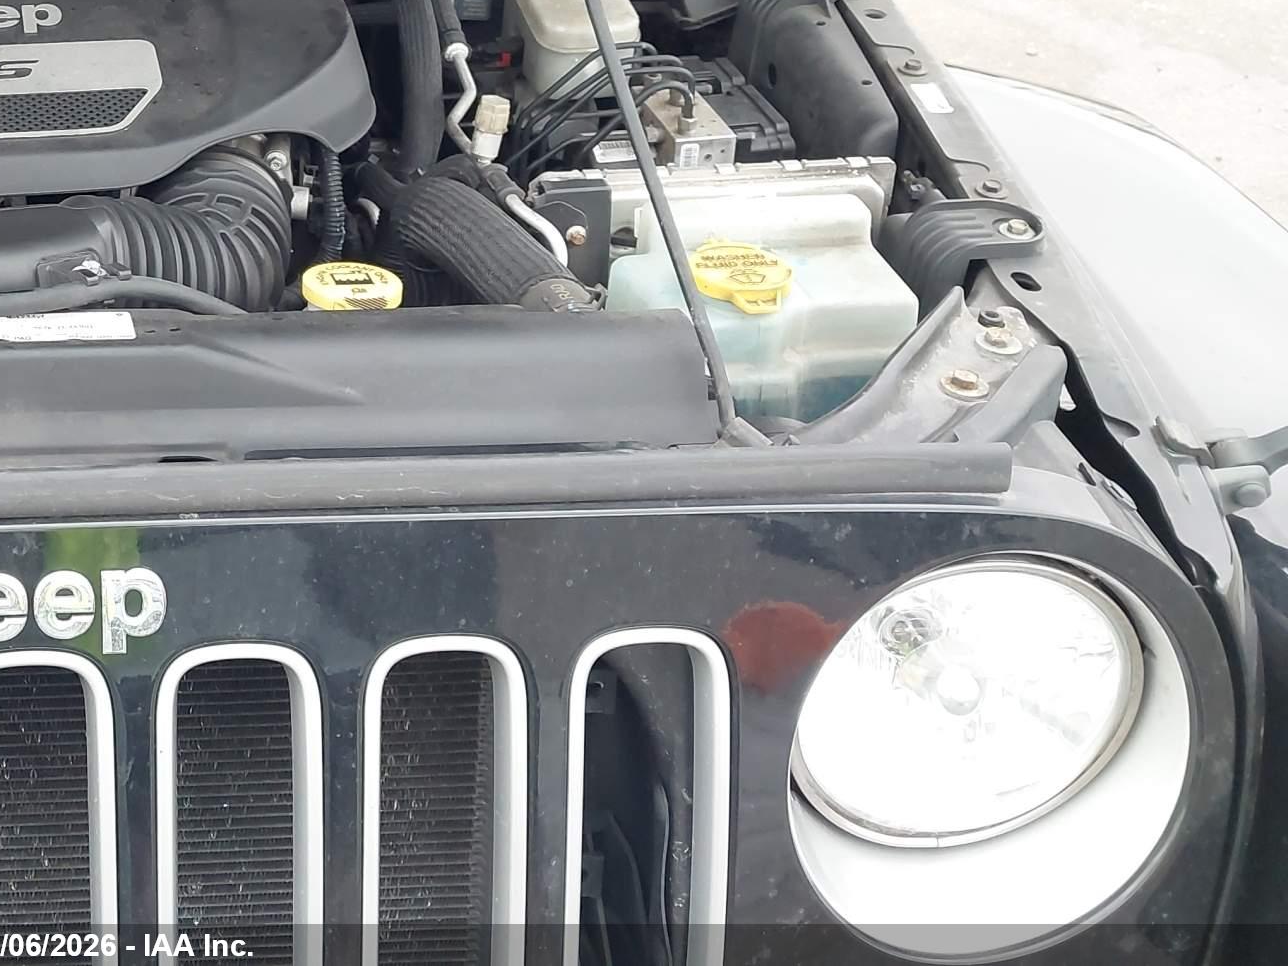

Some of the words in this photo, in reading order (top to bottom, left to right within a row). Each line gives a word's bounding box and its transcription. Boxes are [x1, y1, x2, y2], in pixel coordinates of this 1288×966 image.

[700, 253, 766, 261] WASHER
[695, 261, 738, 269] FLUID
[741, 259, 778, 267] ONLY
